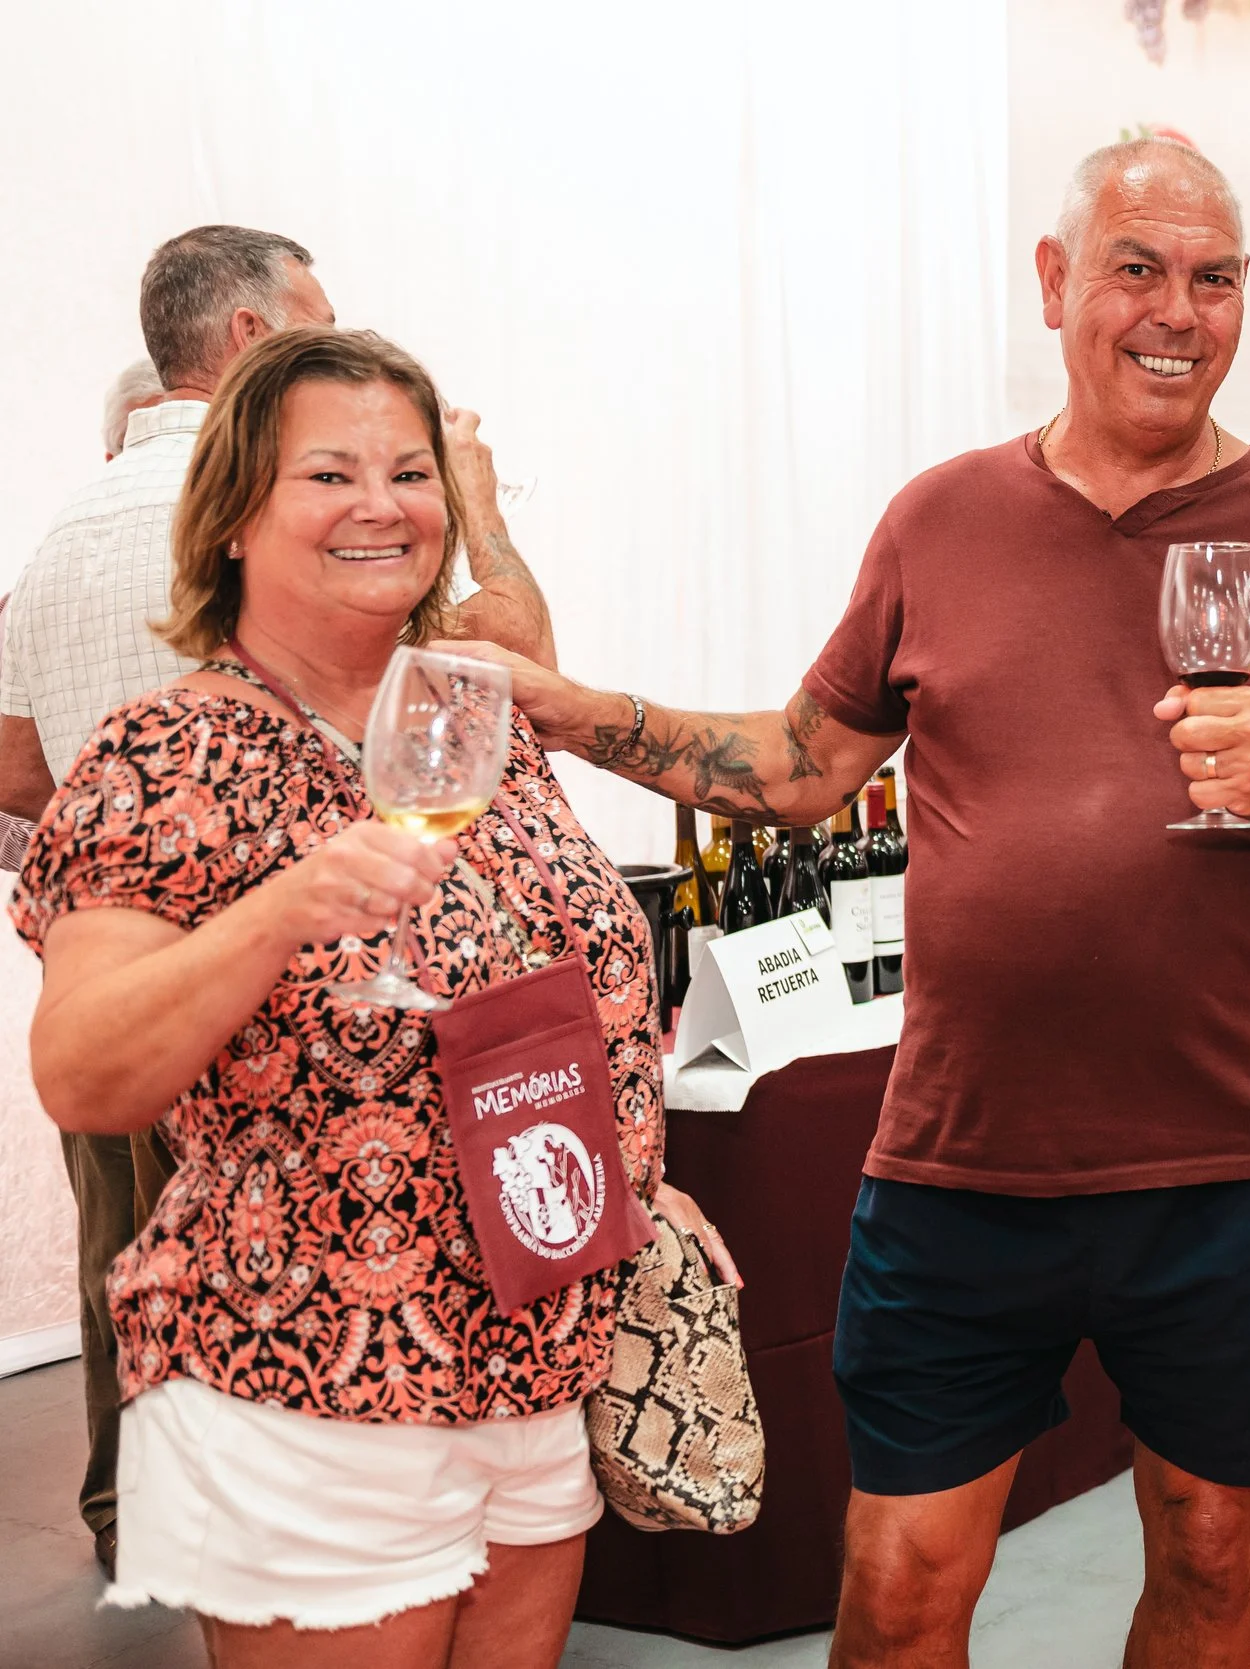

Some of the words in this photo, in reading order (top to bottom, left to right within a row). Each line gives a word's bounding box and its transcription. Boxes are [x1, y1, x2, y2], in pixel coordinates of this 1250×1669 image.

[758, 947, 802, 976] ABADIA
[757, 967, 820, 1004] RETUERTA
[474, 1062, 582, 1120] MEMÓRIAS
